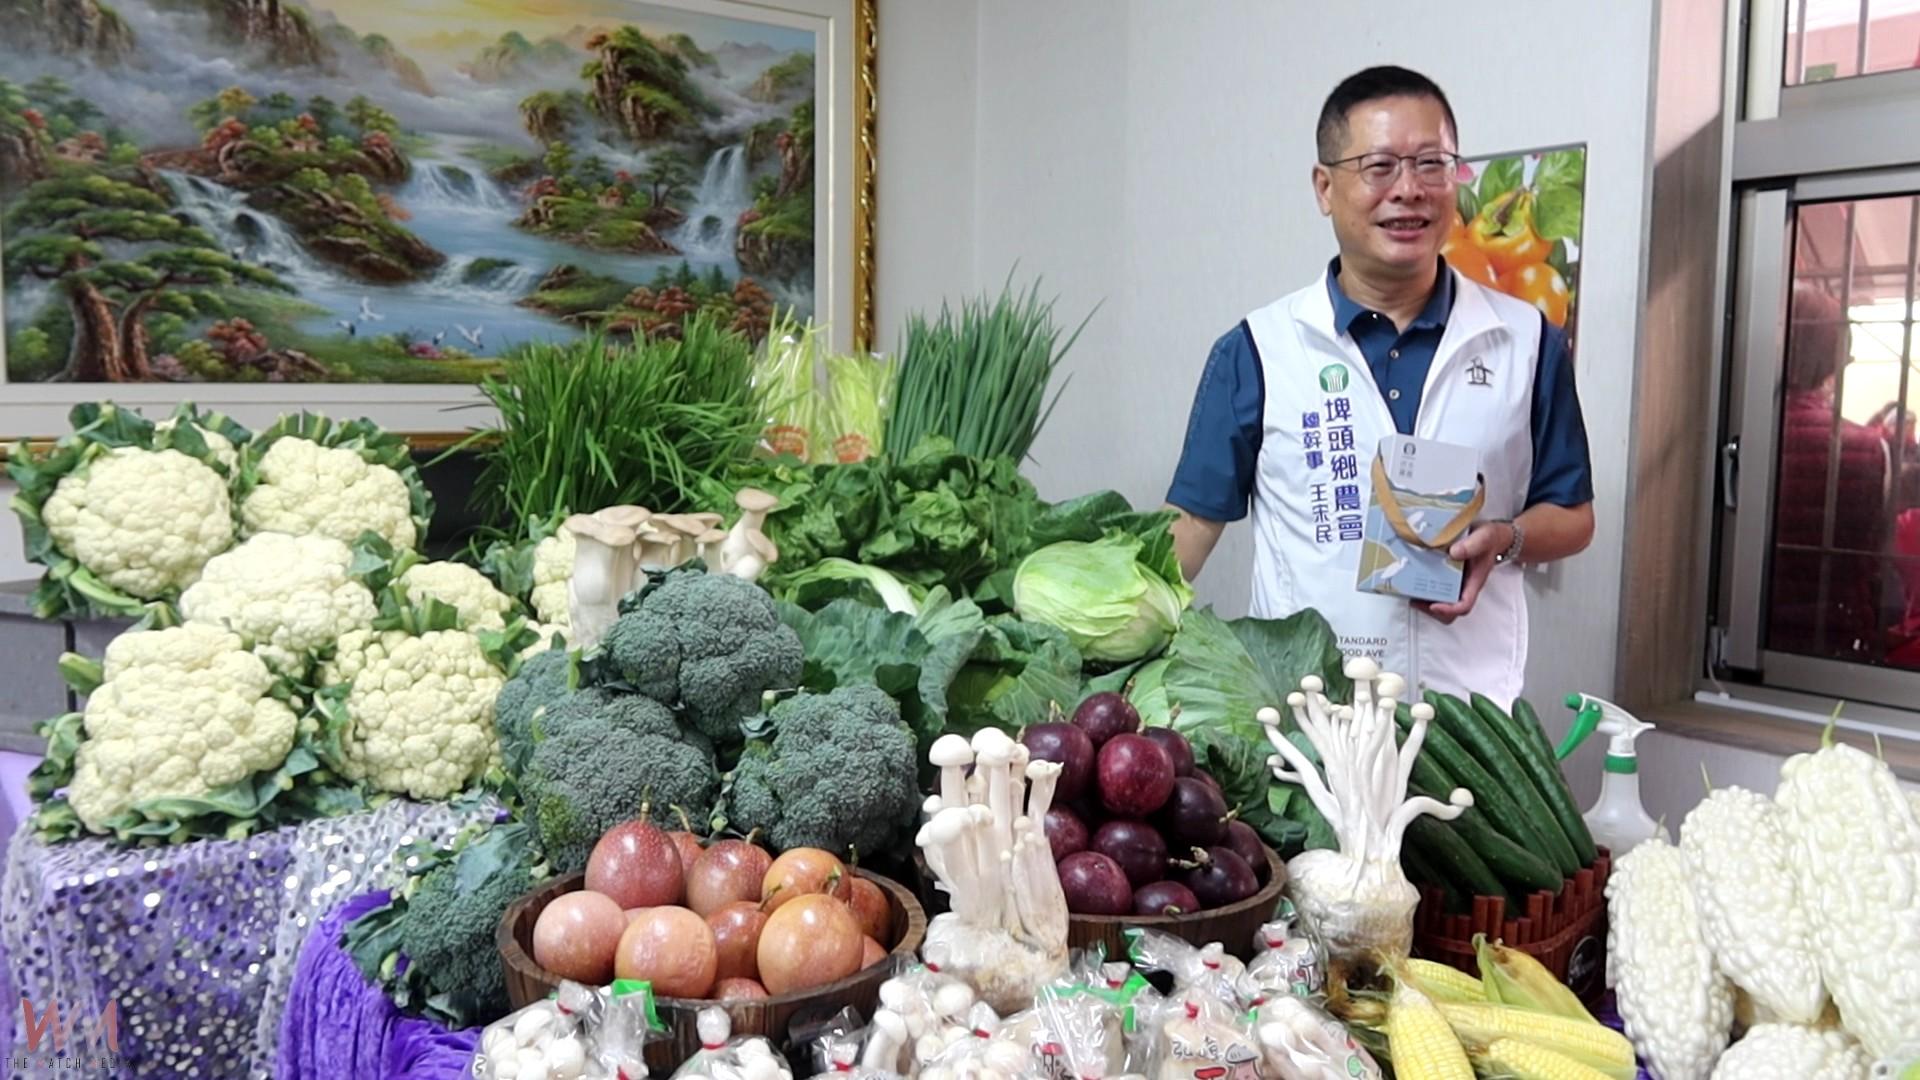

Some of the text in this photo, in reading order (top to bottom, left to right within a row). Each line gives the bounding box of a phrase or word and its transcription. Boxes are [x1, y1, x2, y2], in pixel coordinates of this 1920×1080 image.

[1324, 397, 1363, 541] 埤頭鄉農會
[1339, 636, 1388, 646] TANDARD
